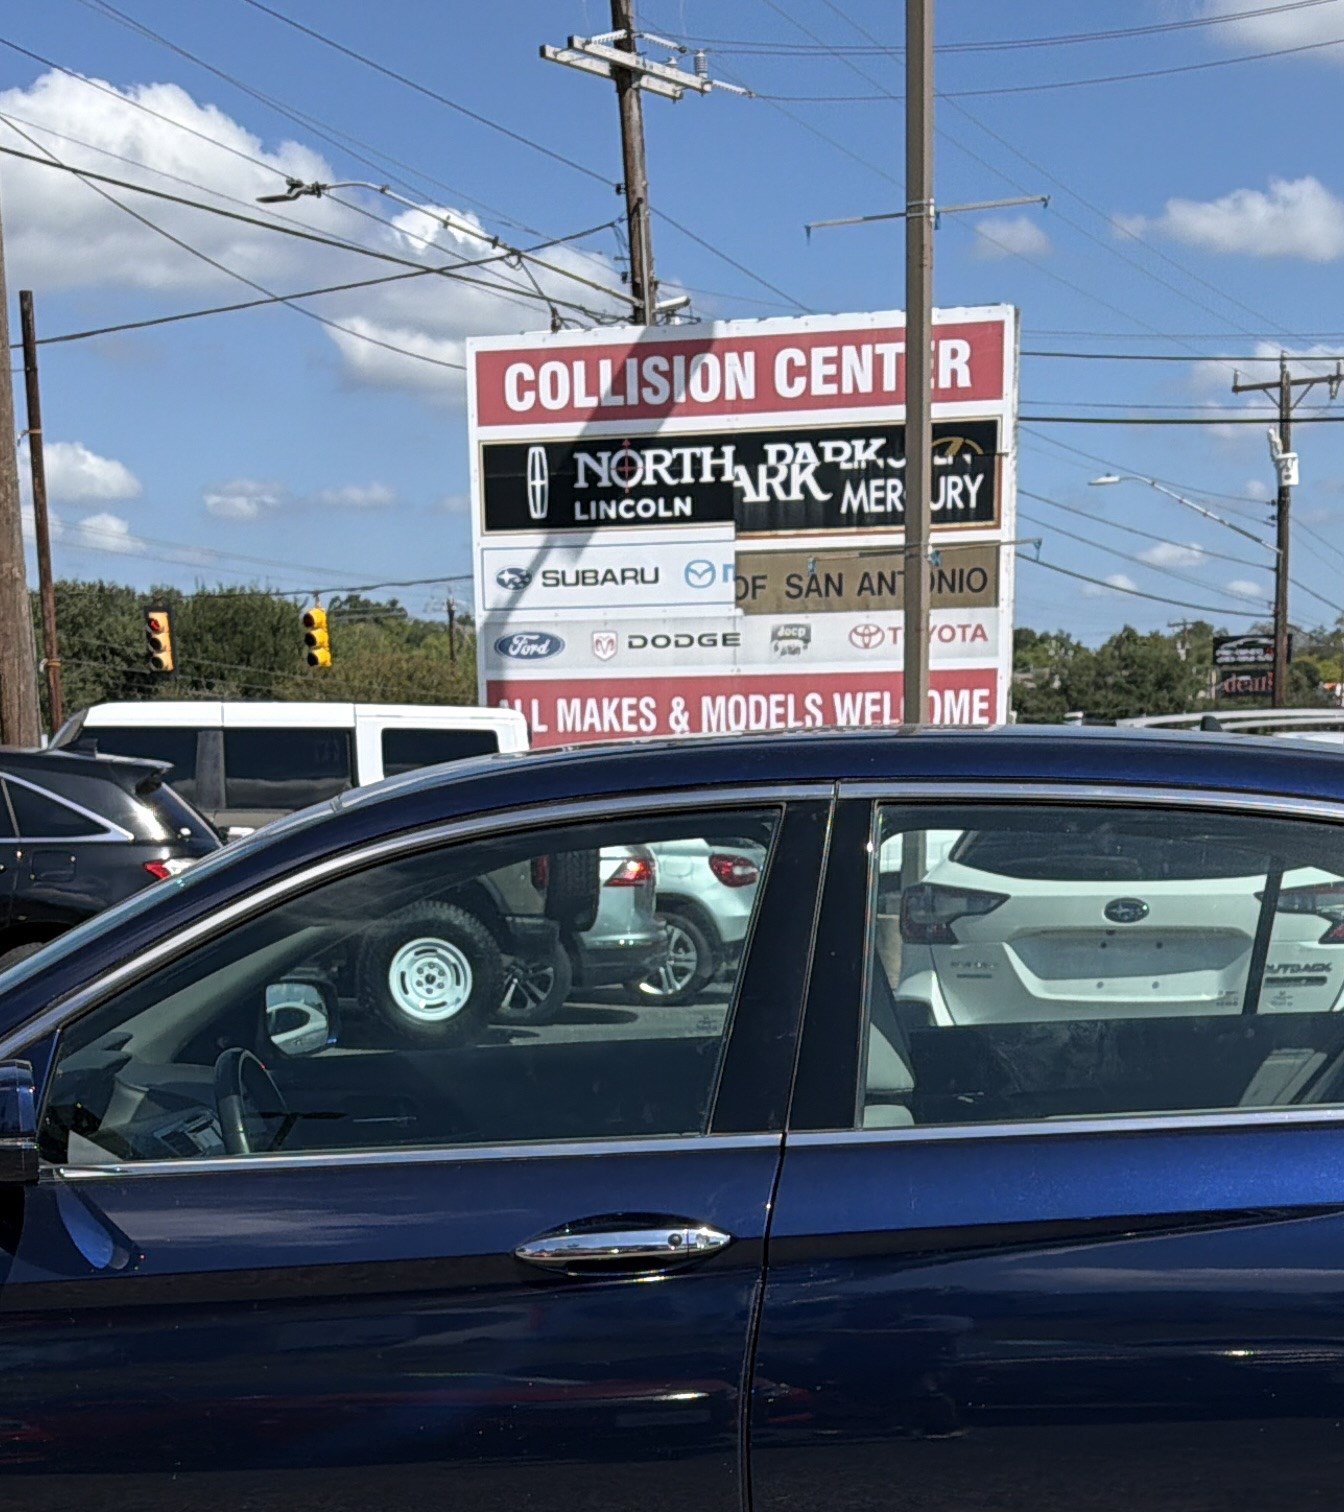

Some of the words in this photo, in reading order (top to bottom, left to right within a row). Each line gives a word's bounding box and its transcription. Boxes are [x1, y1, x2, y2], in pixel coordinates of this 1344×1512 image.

[504, 351, 756, 412] COLLISION
[773, 338, 972, 399] CENTR
[573, 444, 736, 489] NORTH
[839, 473, 984, 514] MERURY
[573, 496, 693, 521] LINCOLN
[541, 567, 660, 588] SUBARU
[735, 574, 768, 601] OF
[785, 572, 844, 600] SAN
[507, 633, 551, 657] Ford
[627, 631, 742, 650] DODGE
[888, 623, 989, 646] TYOTA
[556, 695, 657, 733] MAKES
[669, 697, 690, 734] &
[701, 691, 824, 733] MODELS
[833, 687, 990, 726] WELOME
[1265, 961, 1332, 974] UTBACK
